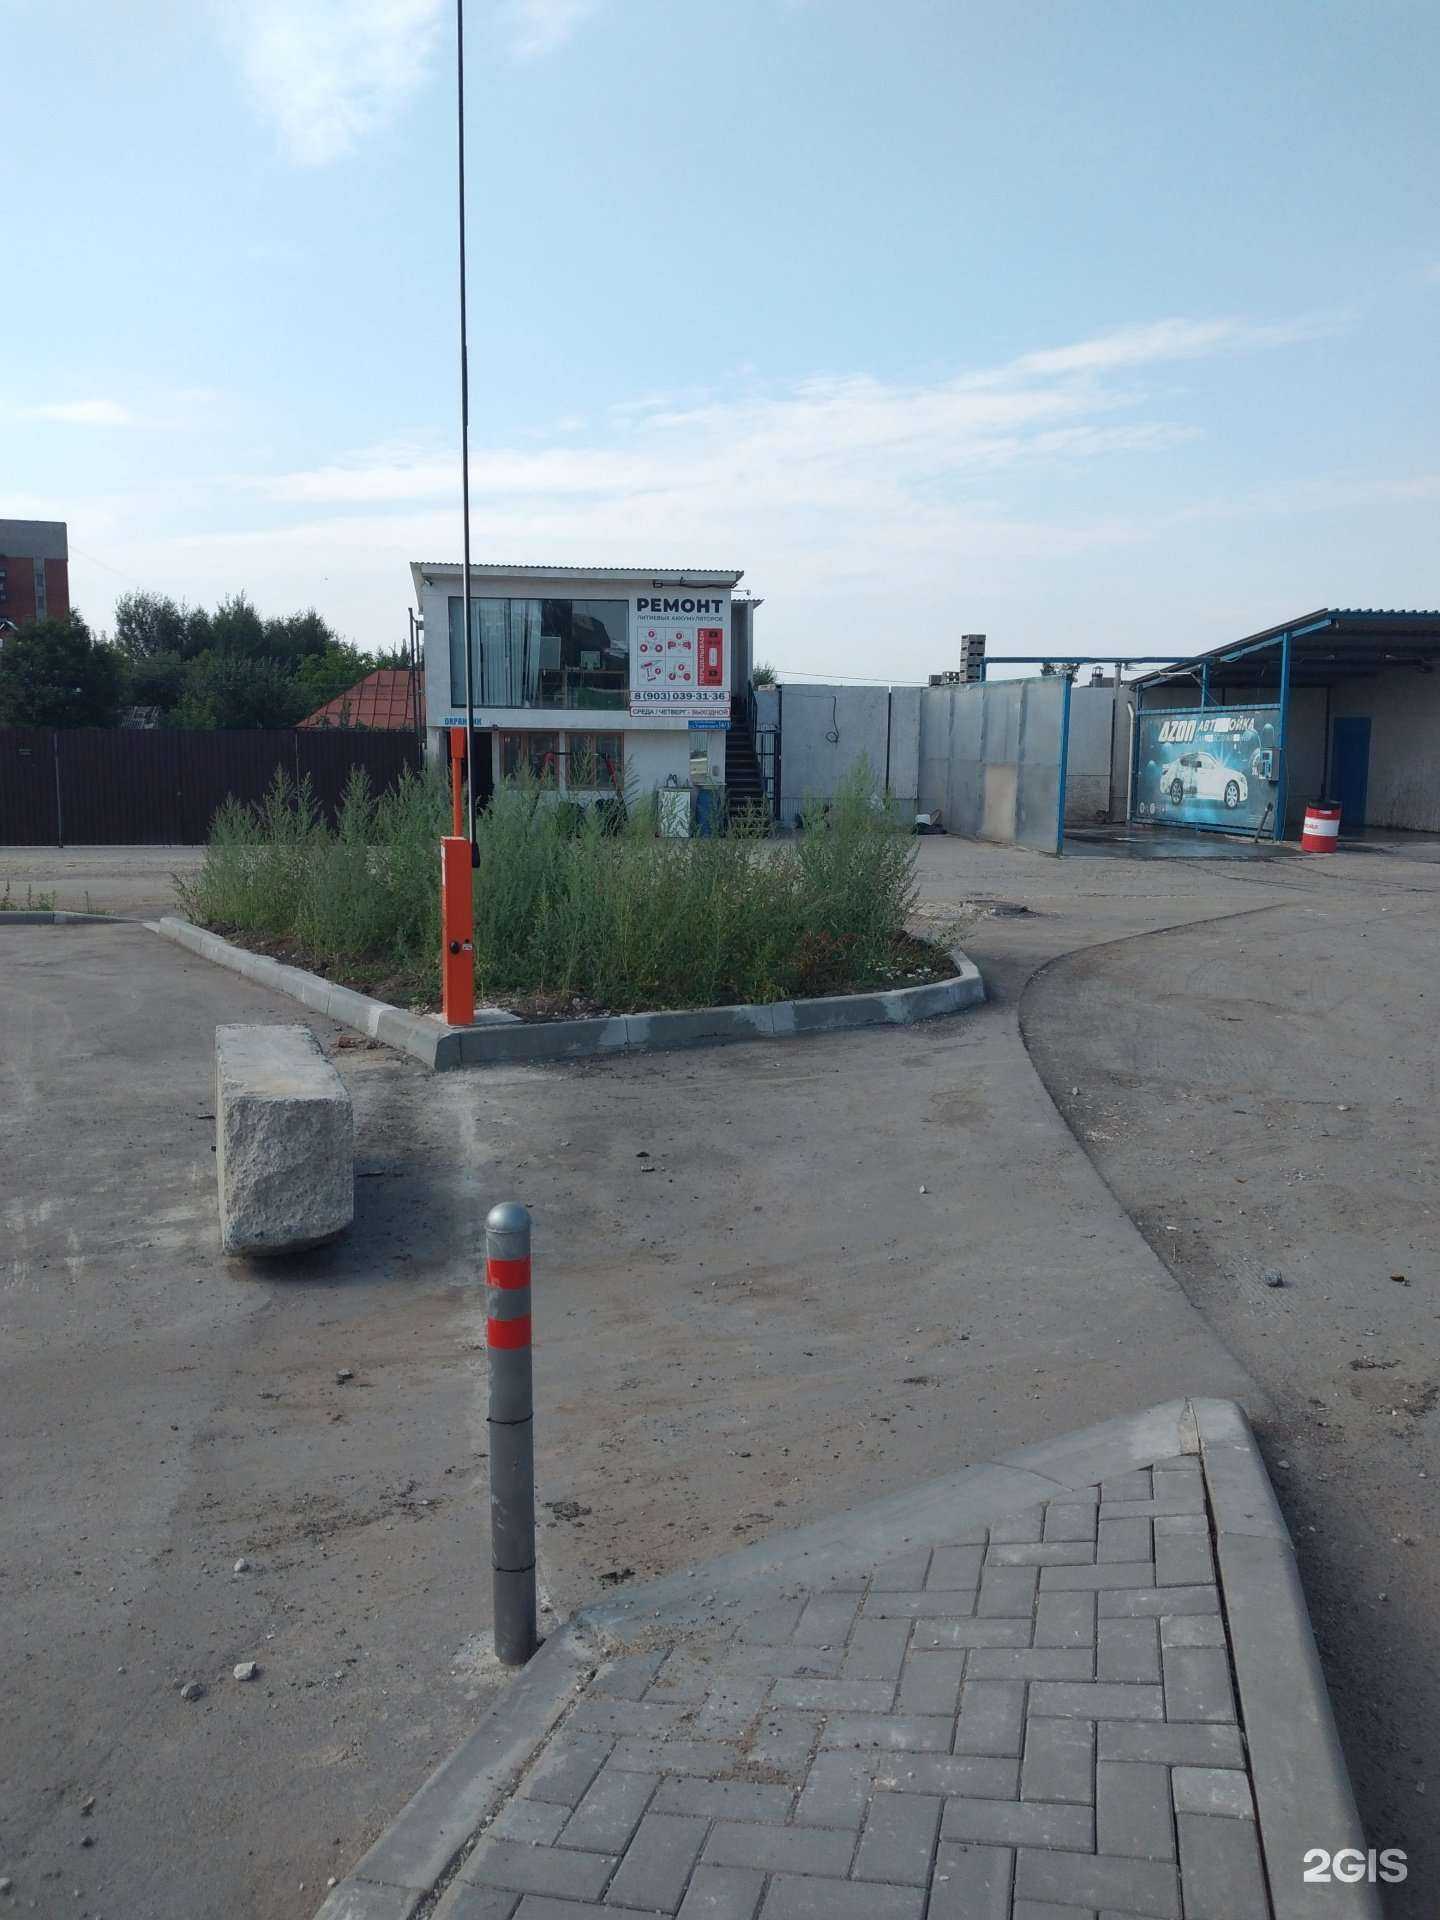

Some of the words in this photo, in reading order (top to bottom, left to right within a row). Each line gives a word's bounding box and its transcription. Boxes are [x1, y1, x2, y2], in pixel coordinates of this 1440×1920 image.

[637, 598, 723, 613] РЕМОНТ
[634, 692, 641, 700] 8
[643, 692, 670, 701] (903)
[1199, 716, 1255, 732] АВТОЙКА
